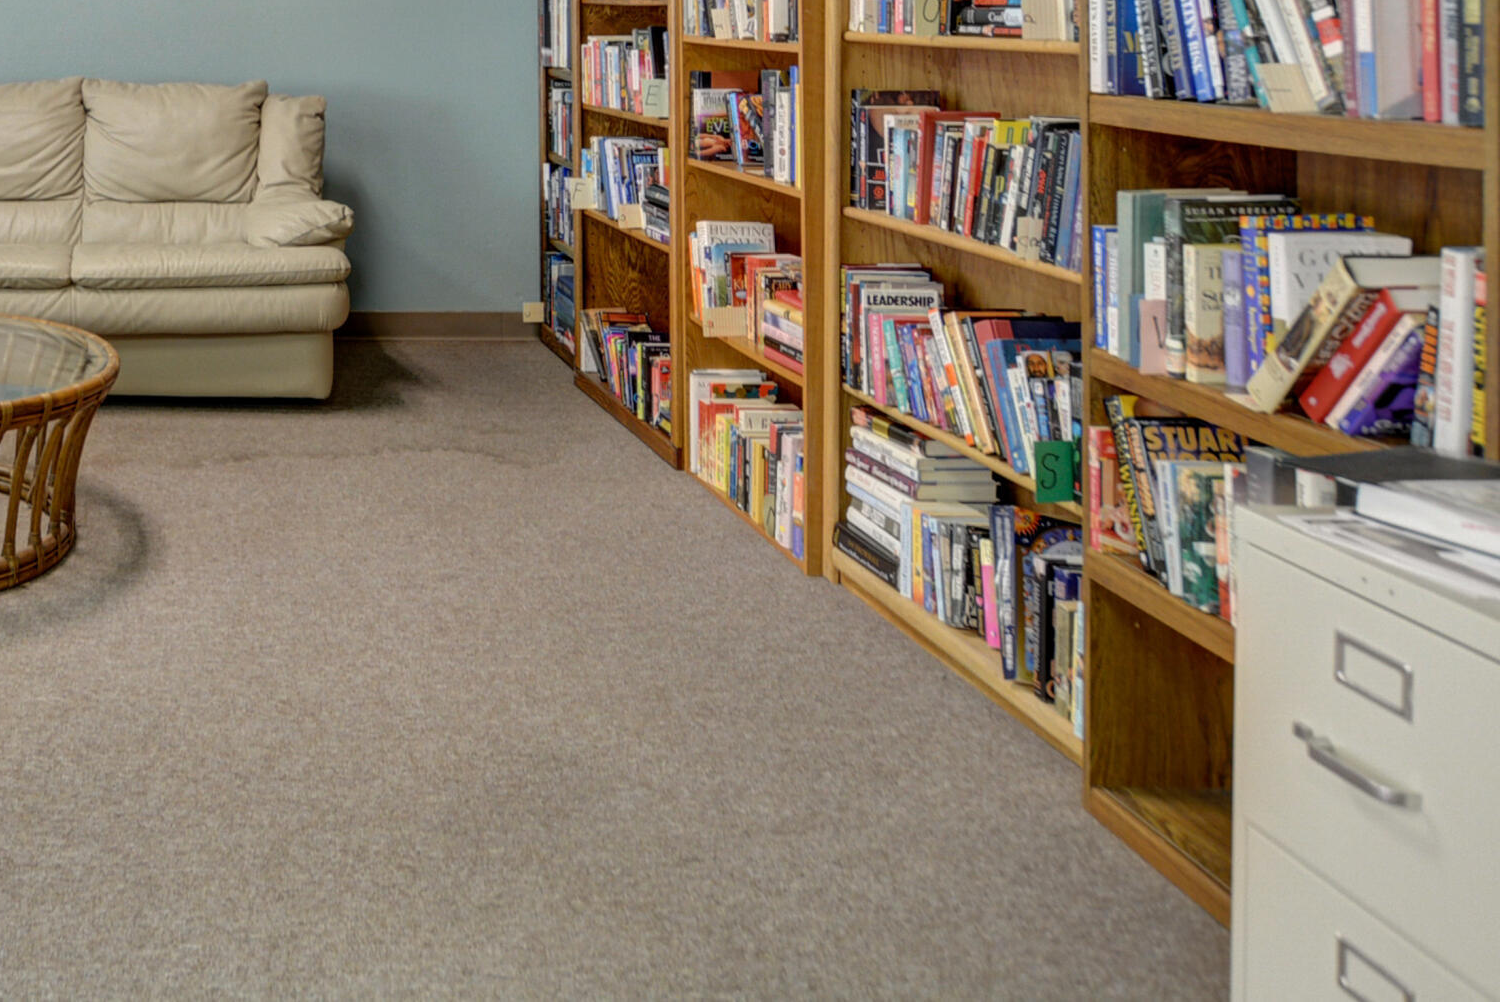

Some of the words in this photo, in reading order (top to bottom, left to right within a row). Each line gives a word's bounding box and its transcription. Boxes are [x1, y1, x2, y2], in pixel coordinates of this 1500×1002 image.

[644, 84, 662, 106] E
[1183, 206, 1225, 216] SUSAN
[709, 224, 772, 238] HUNTING
[866, 294, 935, 308] LEADERSHIP
[1040, 452, 1060, 490] S
[1118, 463, 1147, 551] WINNING
